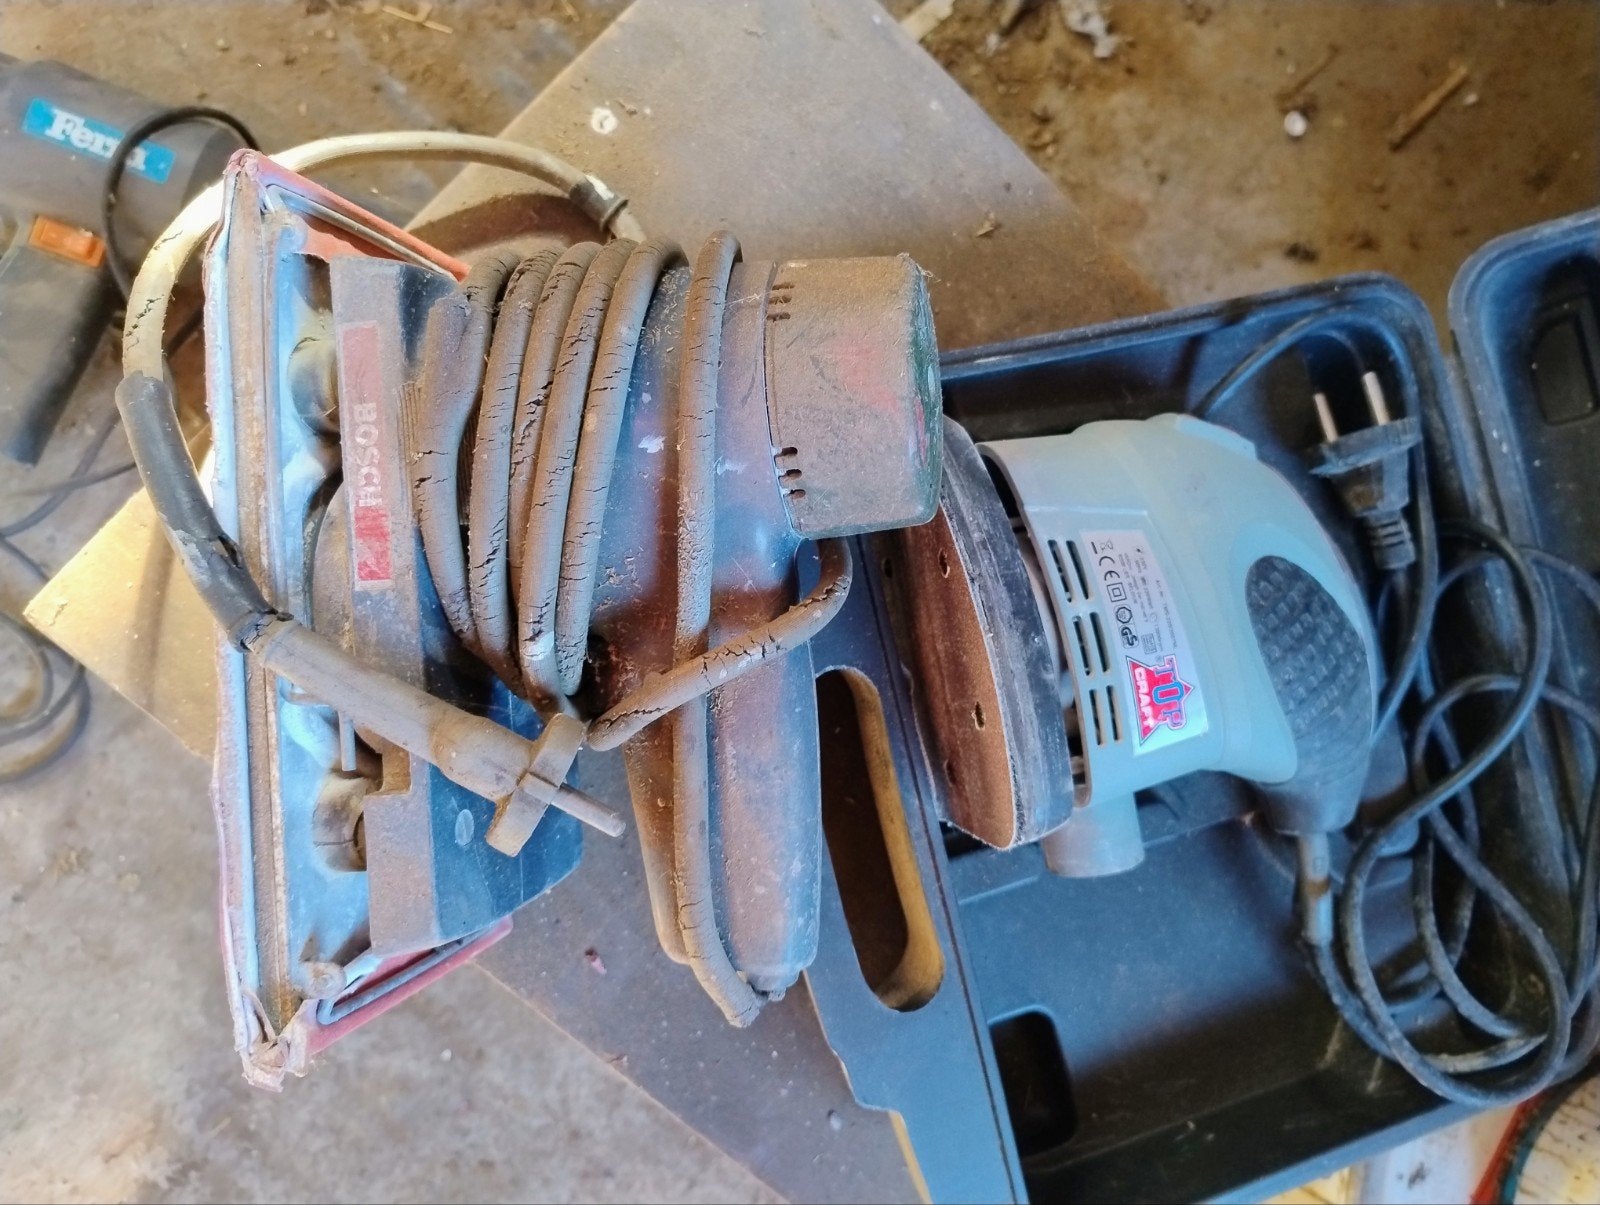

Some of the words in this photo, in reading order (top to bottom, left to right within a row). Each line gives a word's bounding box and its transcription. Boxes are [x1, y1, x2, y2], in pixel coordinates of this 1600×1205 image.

[353, 402, 383, 508] BOSCH
[1133, 666, 1156, 728] CRAFT
[1152, 656, 1187, 730] TOP
